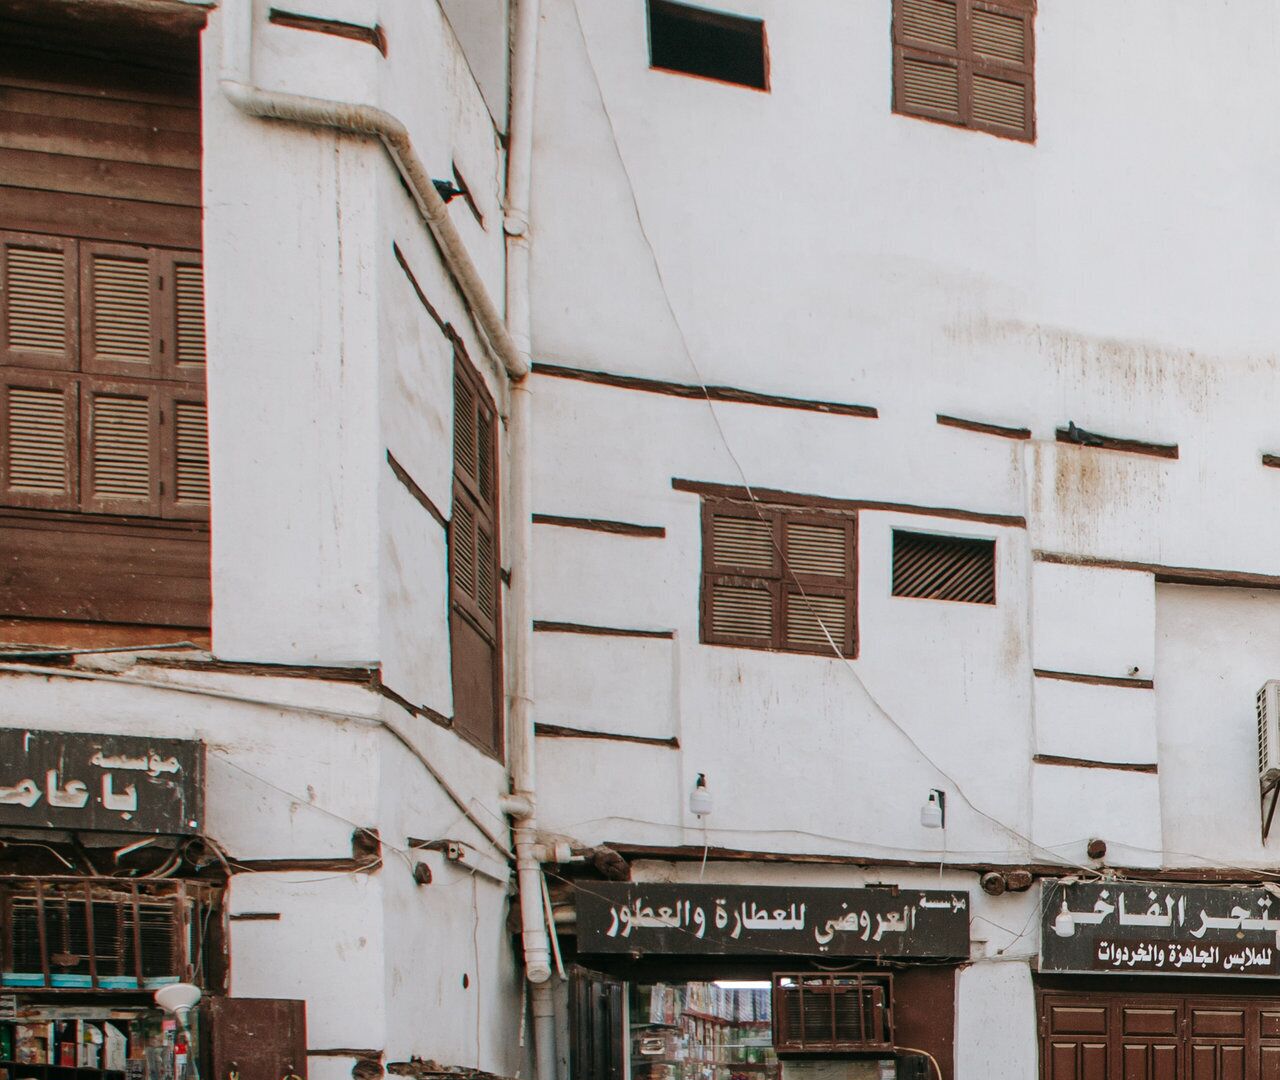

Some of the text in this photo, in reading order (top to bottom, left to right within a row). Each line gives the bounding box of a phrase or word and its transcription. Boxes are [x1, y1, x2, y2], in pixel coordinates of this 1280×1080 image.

[90, 745, 181, 777] مؤسسة
[919, 893, 966, 914] مؤسسة
[1051, 889, 1187, 930] الفاخ
[606, 898, 917, 951] العروضي للعطارة والعطور
[1098, 942, 1272, 971] للملابس الجاهزة والخردوات
